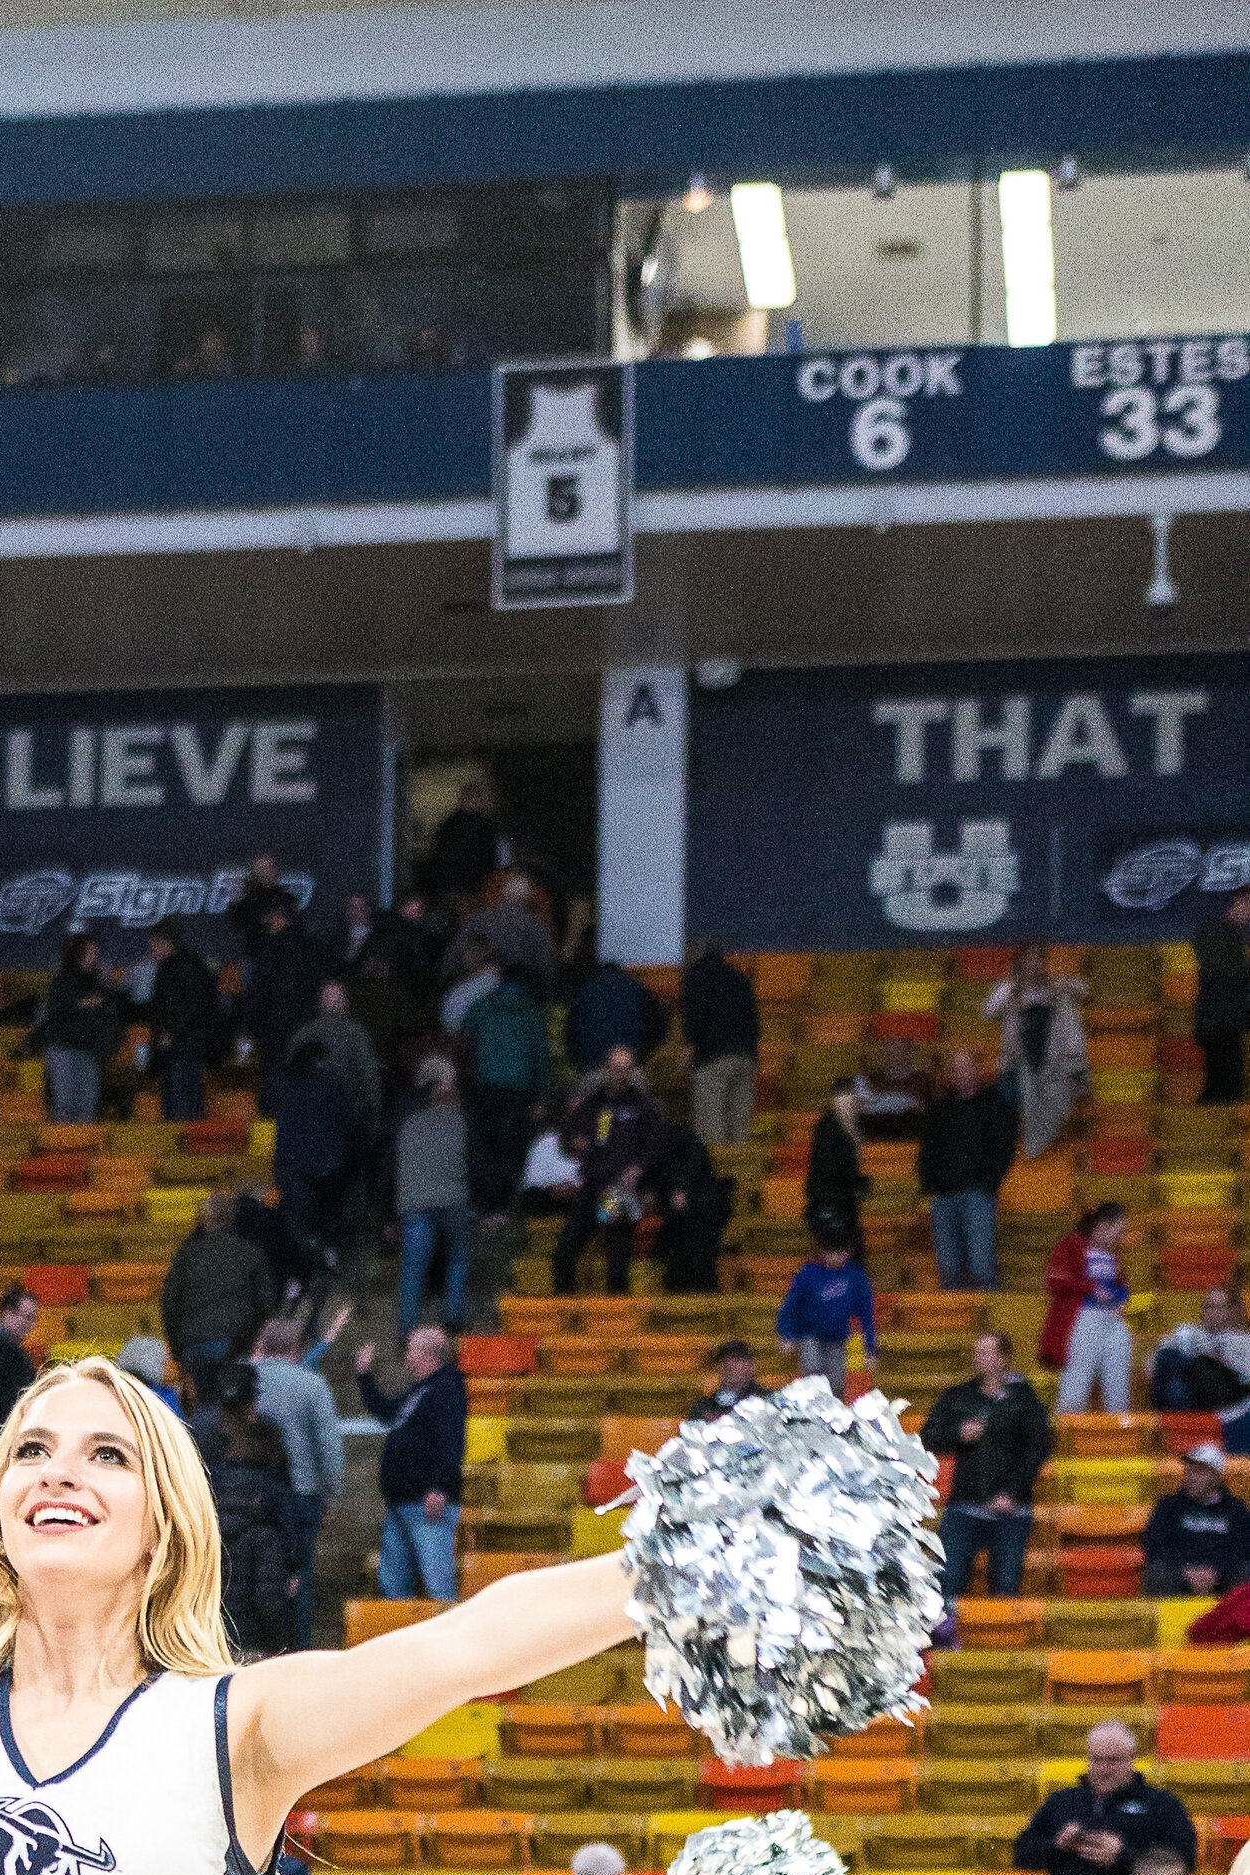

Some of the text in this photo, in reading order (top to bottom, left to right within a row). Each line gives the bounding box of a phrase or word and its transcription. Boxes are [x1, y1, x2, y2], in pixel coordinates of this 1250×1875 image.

[798, 353, 965, 402] COOK
[1071, 339, 1250, 388] ESTES
[851, 398, 912, 472] 6
[1100, 386, 1222, 460] 33
[547, 475, 581, 523] 5
[623, 681, 665, 728] A
[872, 691, 1208, 782] THAT
